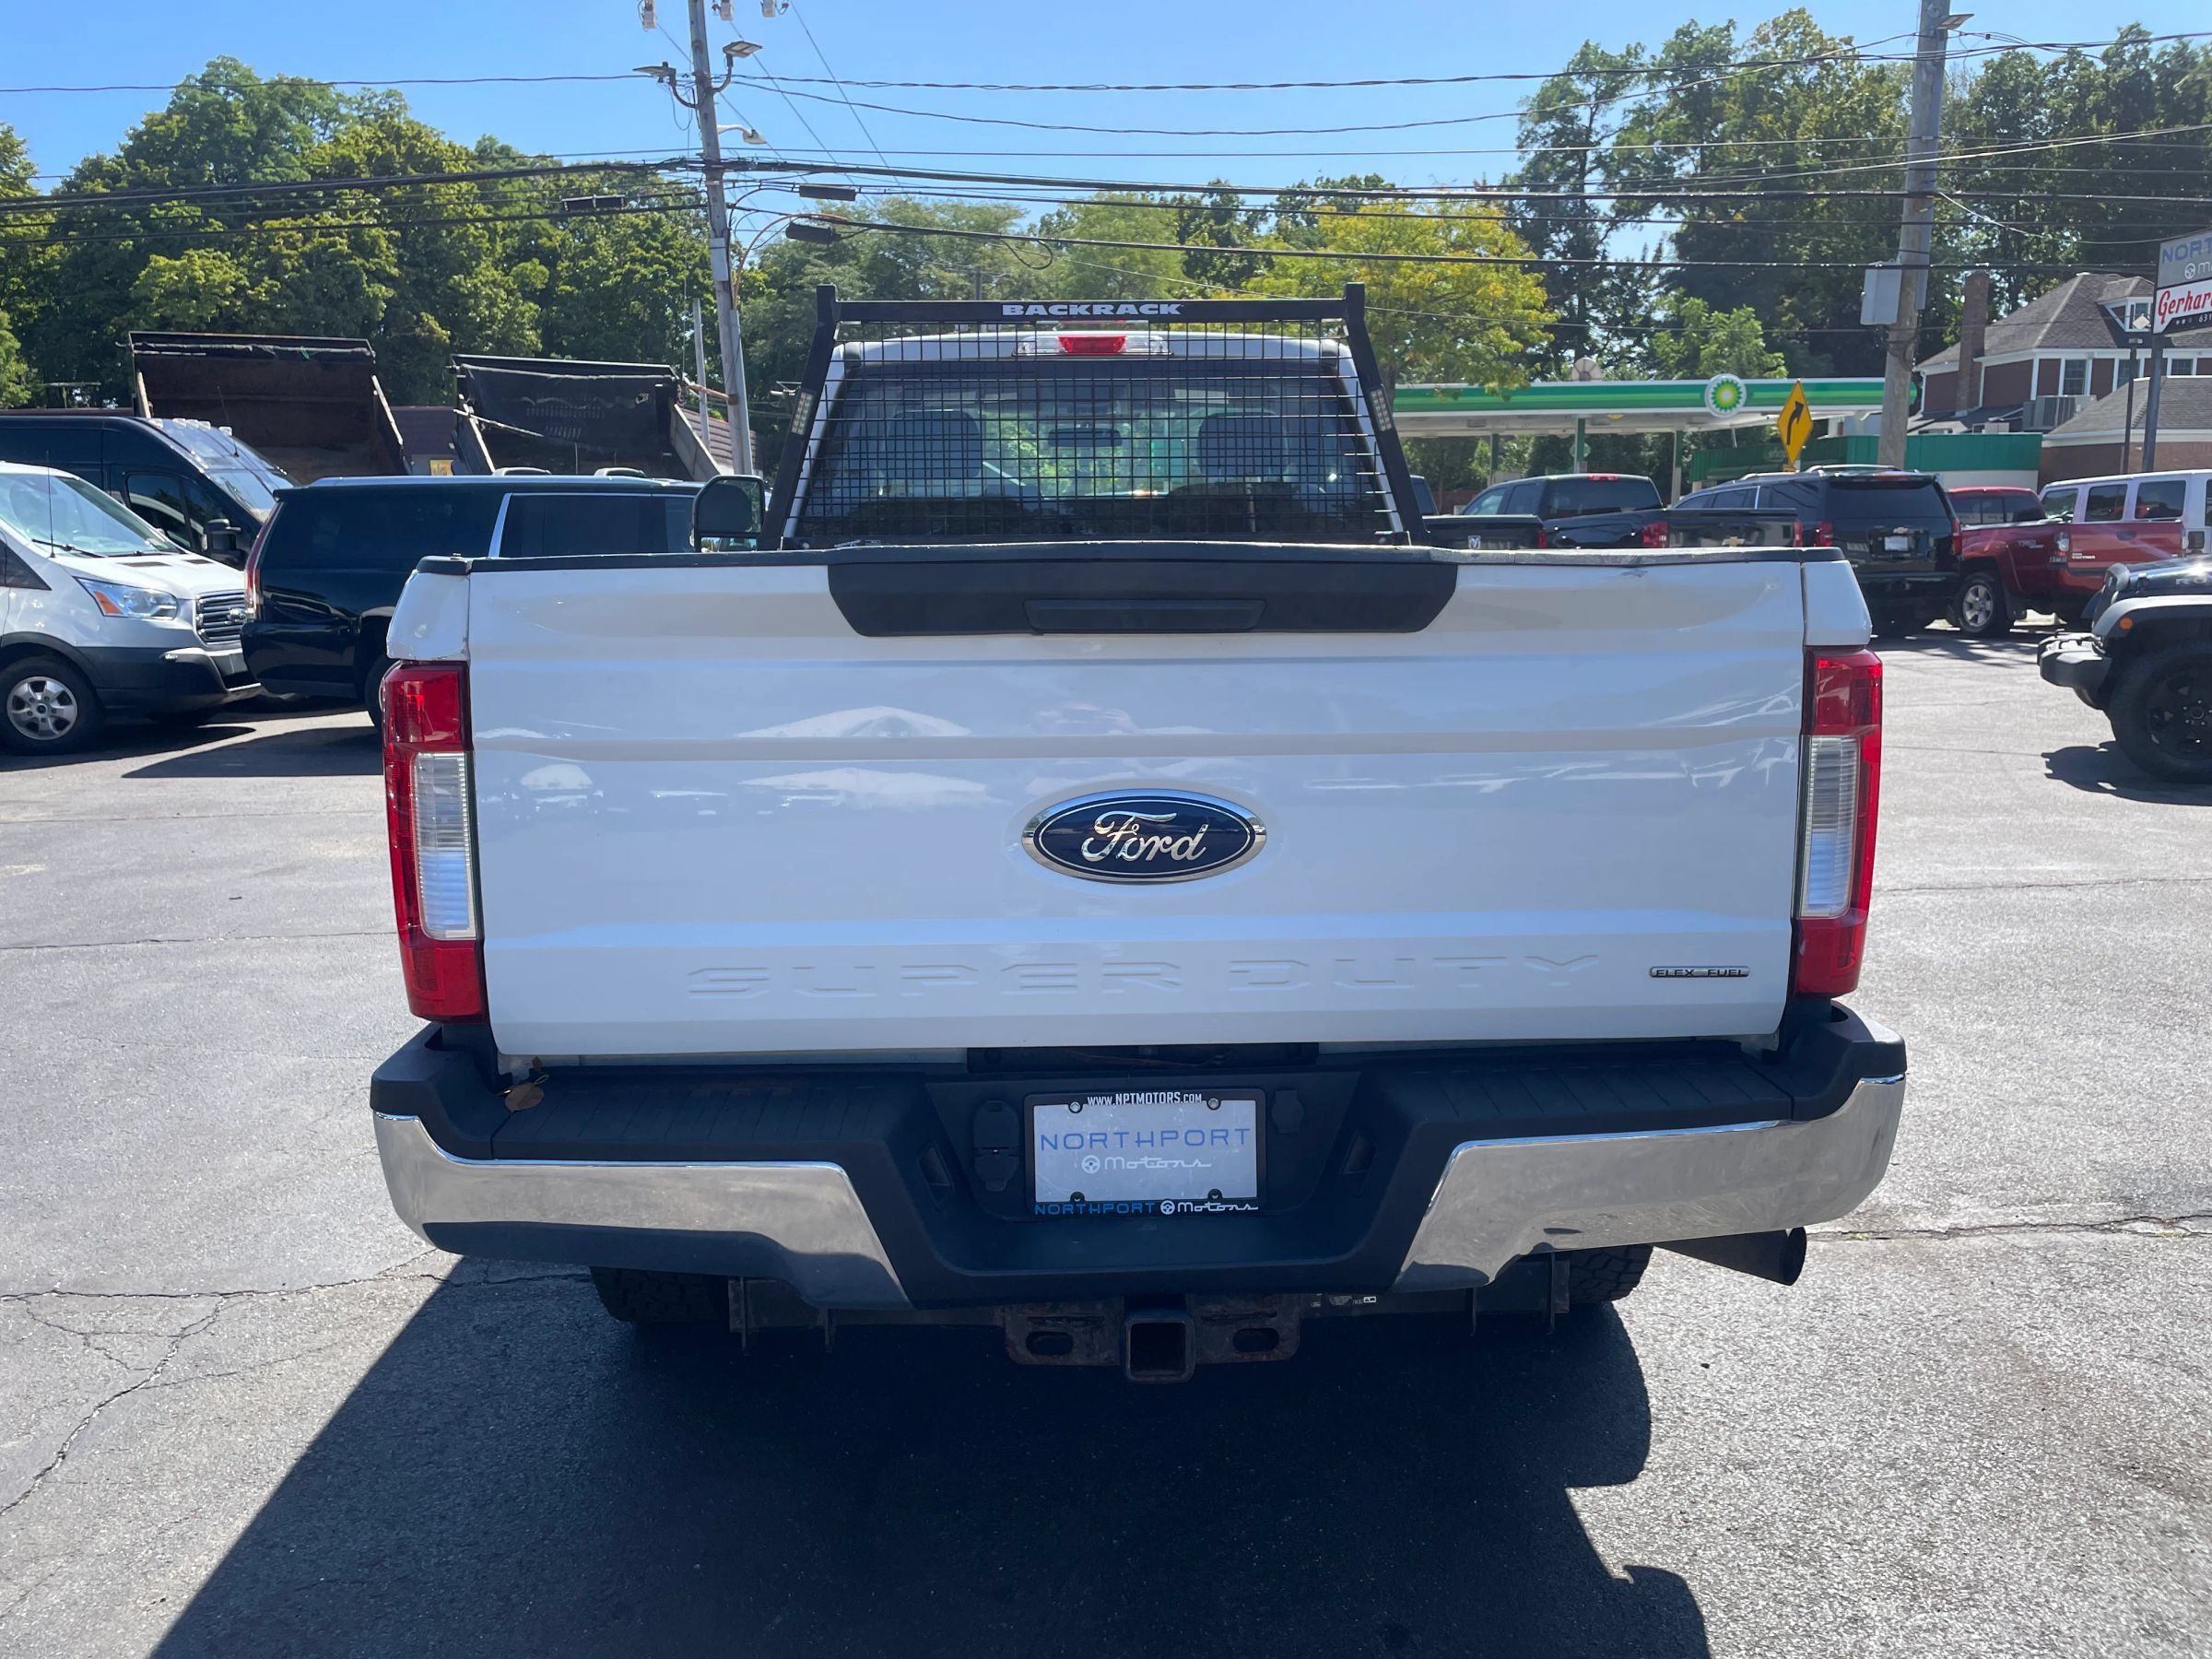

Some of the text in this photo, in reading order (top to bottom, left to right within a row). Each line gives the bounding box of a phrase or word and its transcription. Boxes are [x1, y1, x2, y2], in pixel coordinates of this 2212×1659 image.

[1002, 303, 1182, 316] BACKRACK
[2158, 290, 2212, 325] Gerhar
[1080, 810, 1209, 862] Ford
[688, 954, 1600, 1000] SUPER DUTY
[1655, 969, 1747, 978] FLEX FUEL
[1041, 1127, 1250, 1150] NORTHPORT
[1035, 1201, 1155, 1215] NORTHPORT
